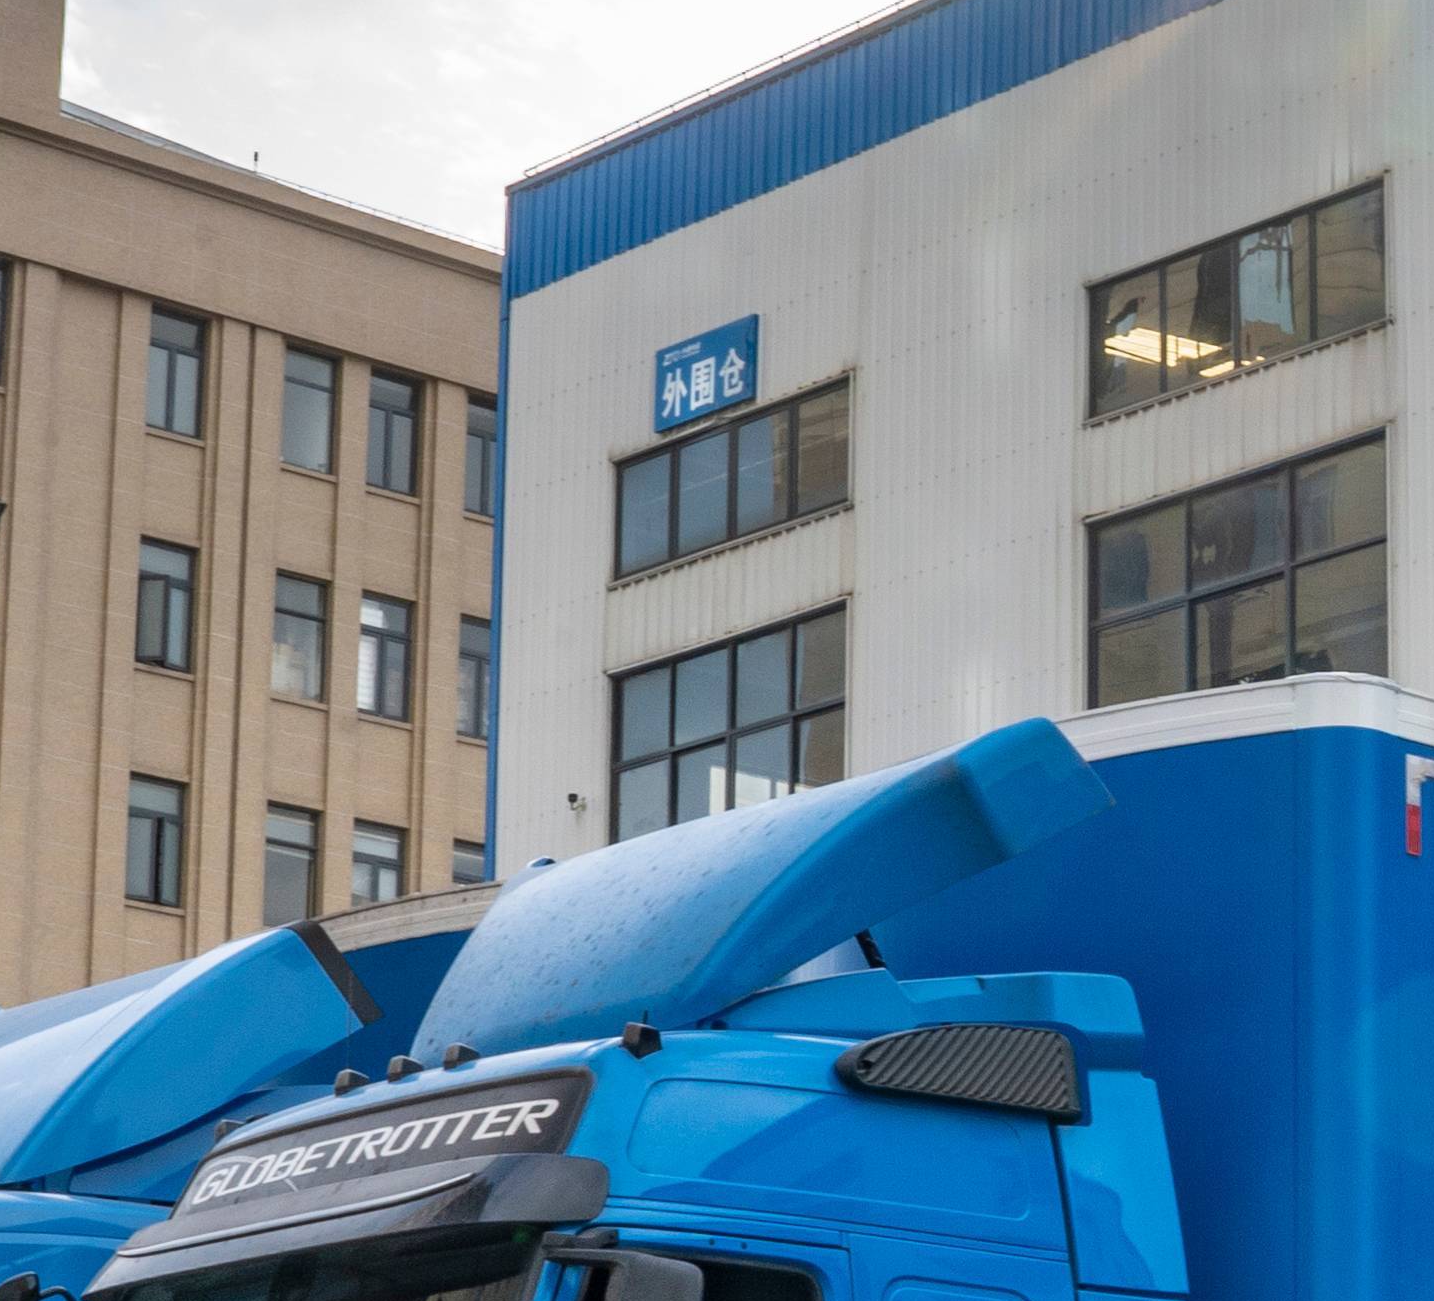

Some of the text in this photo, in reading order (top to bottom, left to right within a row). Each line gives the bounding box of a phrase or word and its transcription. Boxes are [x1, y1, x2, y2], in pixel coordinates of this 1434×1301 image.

[662, 348, 745, 417] 外围仓
[192, 1098, 560, 1205] GLOBETROTTER
